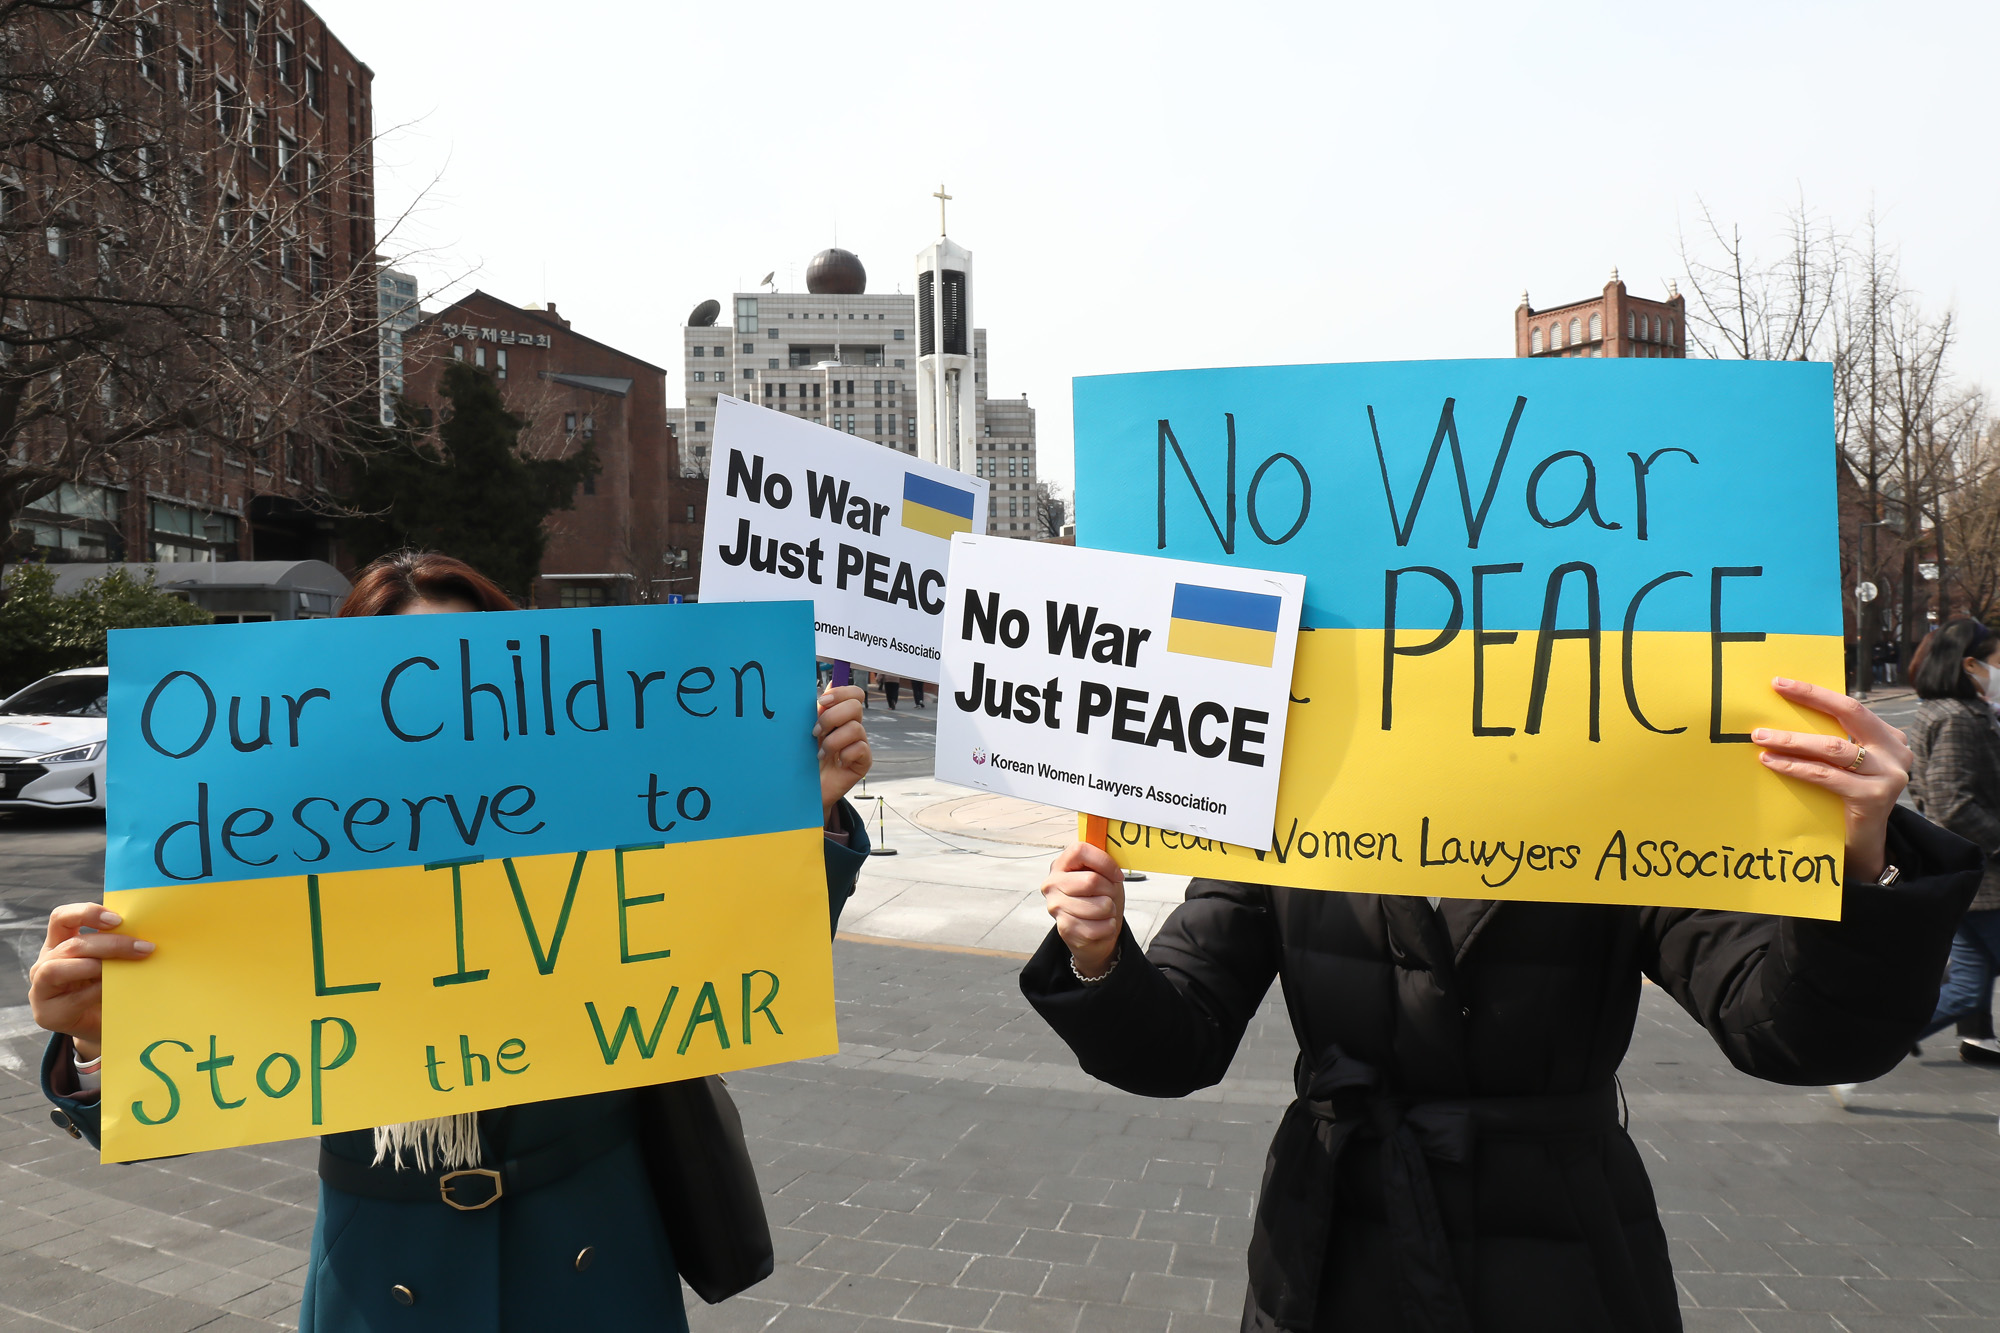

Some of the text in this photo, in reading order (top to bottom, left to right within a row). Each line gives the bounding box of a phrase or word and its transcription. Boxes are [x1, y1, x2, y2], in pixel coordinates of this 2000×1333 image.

[442, 322, 551, 349] 정동제일교회
[727, 449, 890, 536] No War
[1158, 396, 1699, 554] No War
[719, 518, 945, 615] Just PEAC
[814, 621, 941, 661] omen Lawyers Associatio
[962, 589, 1151, 667] No War
[1382, 561, 1766, 743] PEACE
[141, 628, 775, 759] Our Children
[955, 662, 1269, 767] Just PEACE
[154, 773, 711, 880] deserve to
[990, 752, 1227, 815] Korean Women Lawyers Association
[1421, 817, 1580, 887] Lawyers
[307, 842, 671, 997] LIVE
[425, 1035, 529, 1091] the
[585, 970, 783, 1064] WAR
